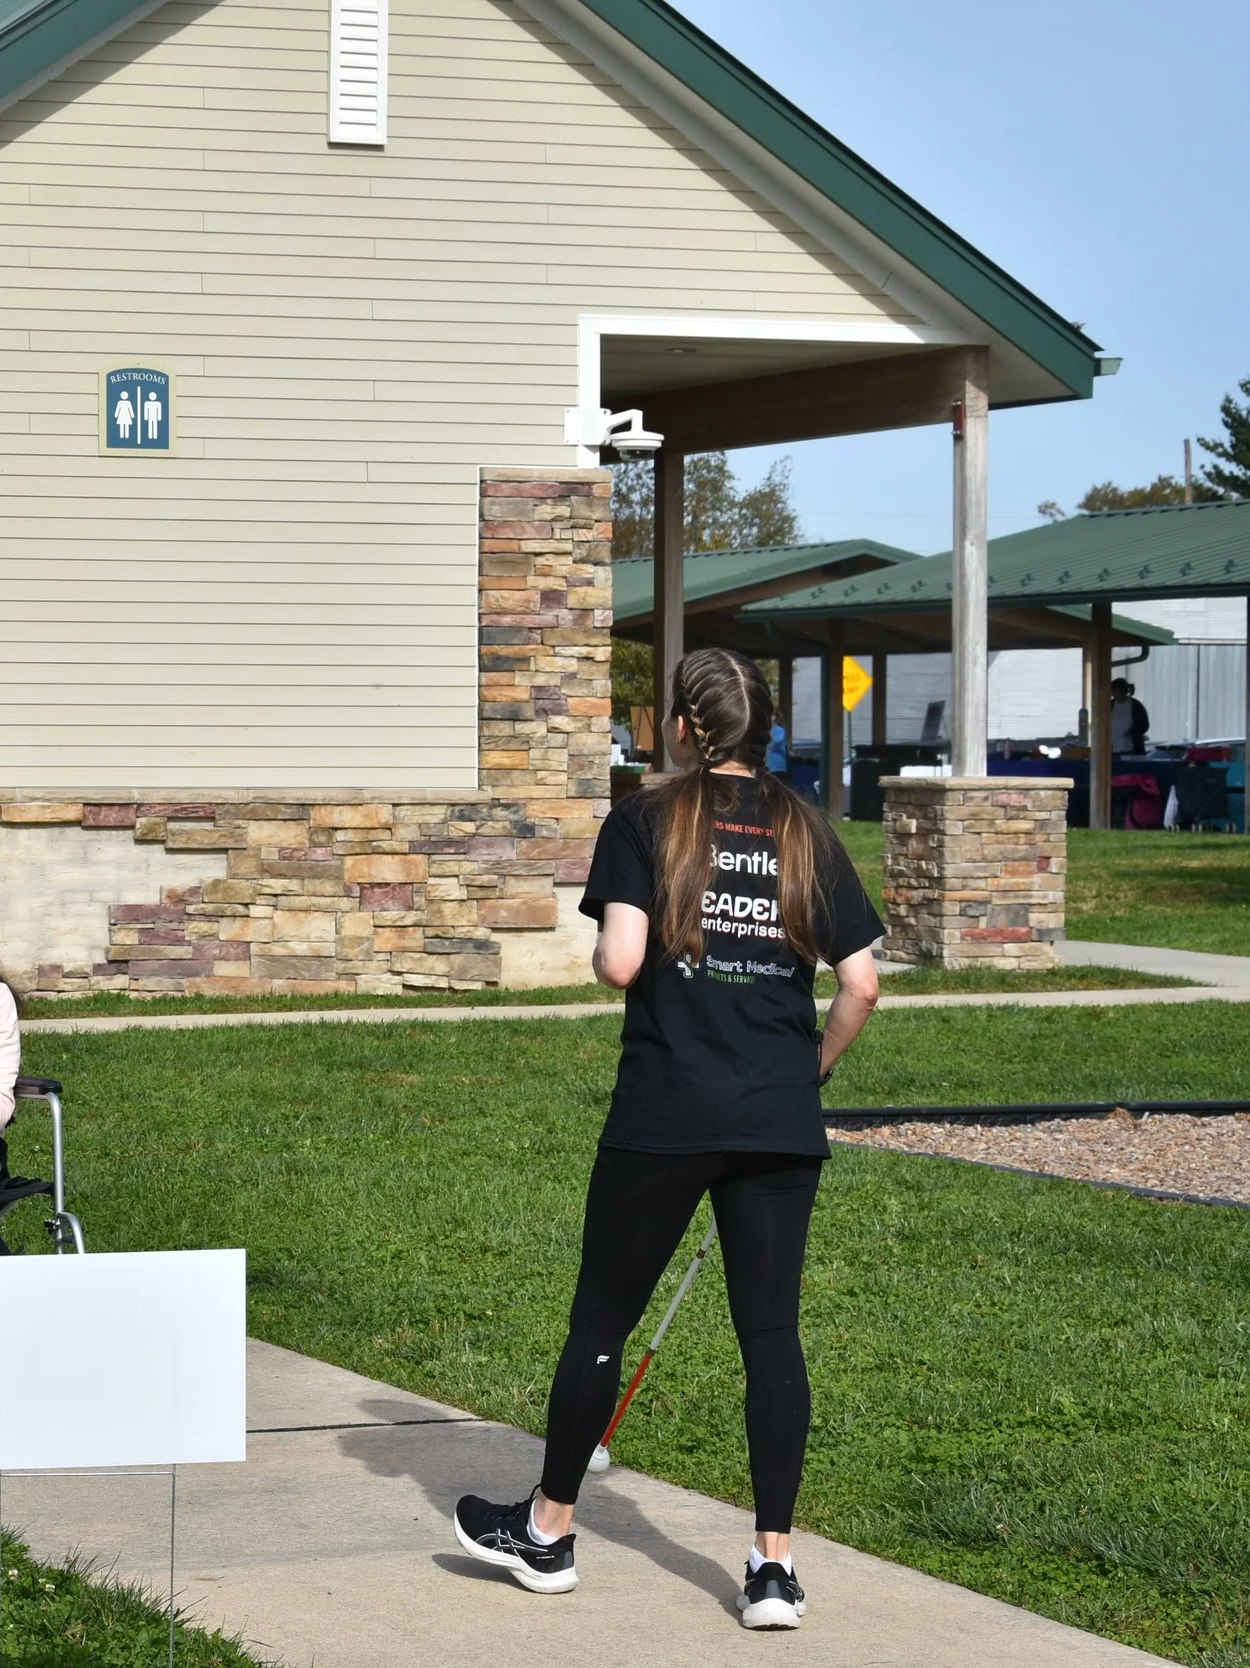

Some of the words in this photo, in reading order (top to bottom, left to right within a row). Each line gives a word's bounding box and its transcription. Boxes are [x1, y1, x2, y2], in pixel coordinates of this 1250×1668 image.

[110, 372, 166, 385] RESTROOMS
[725, 822, 743, 833] MAKE
[701, 917, 786, 939] enterprises
[706, 954, 743, 973] Smart
[746, 960, 795, 977] Medical
